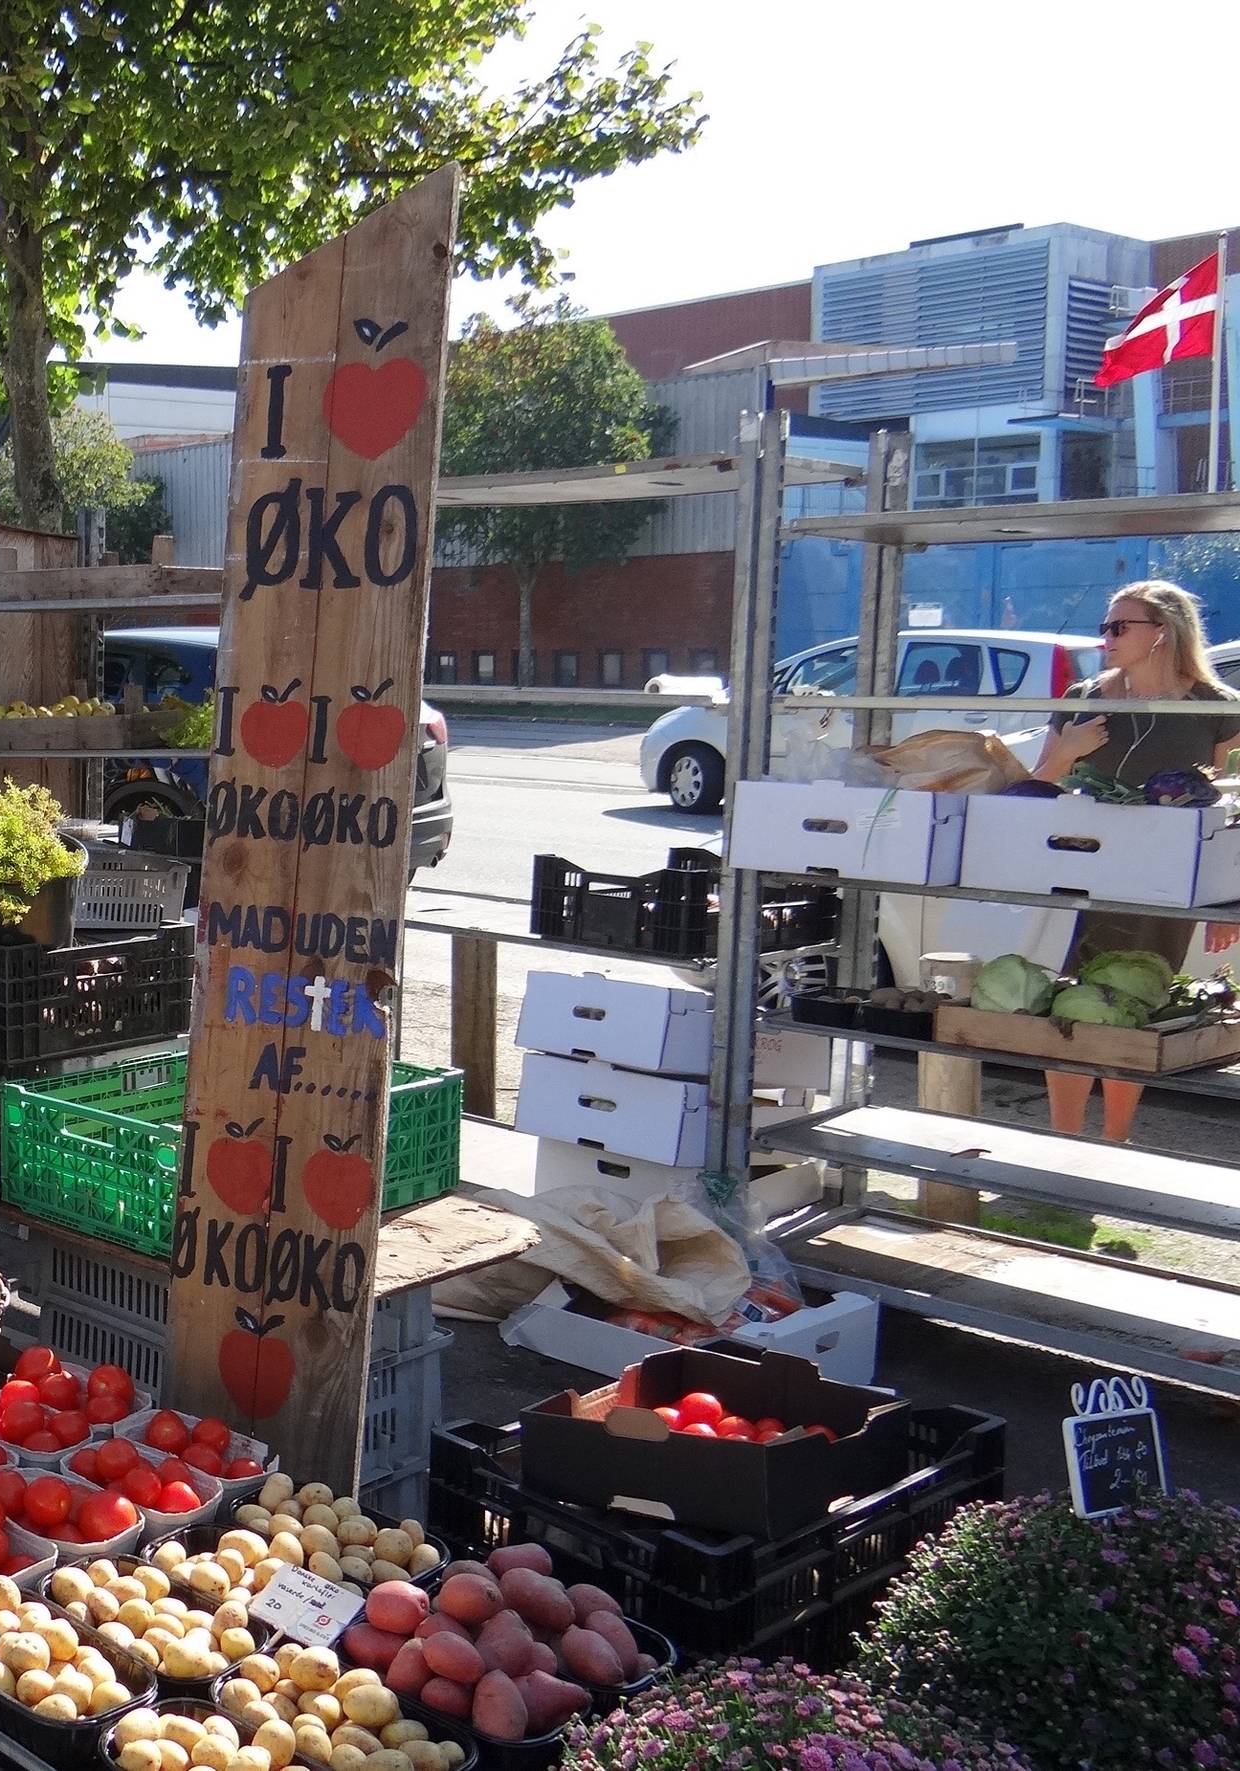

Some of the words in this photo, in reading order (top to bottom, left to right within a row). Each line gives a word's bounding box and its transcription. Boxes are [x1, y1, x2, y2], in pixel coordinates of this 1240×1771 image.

[261, 365, 292, 459] I
[239, 478, 418, 600] ØKO
[214, 686, 239, 757] I
[308, 695, 333, 764] I
[208, 902, 291, 953] MAD
[294, 912, 397, 967] UDEN
[178, 1121, 200, 1199] I
[271, 1135, 292, 1213] I
[265, 1598, 282, 1610] 20
